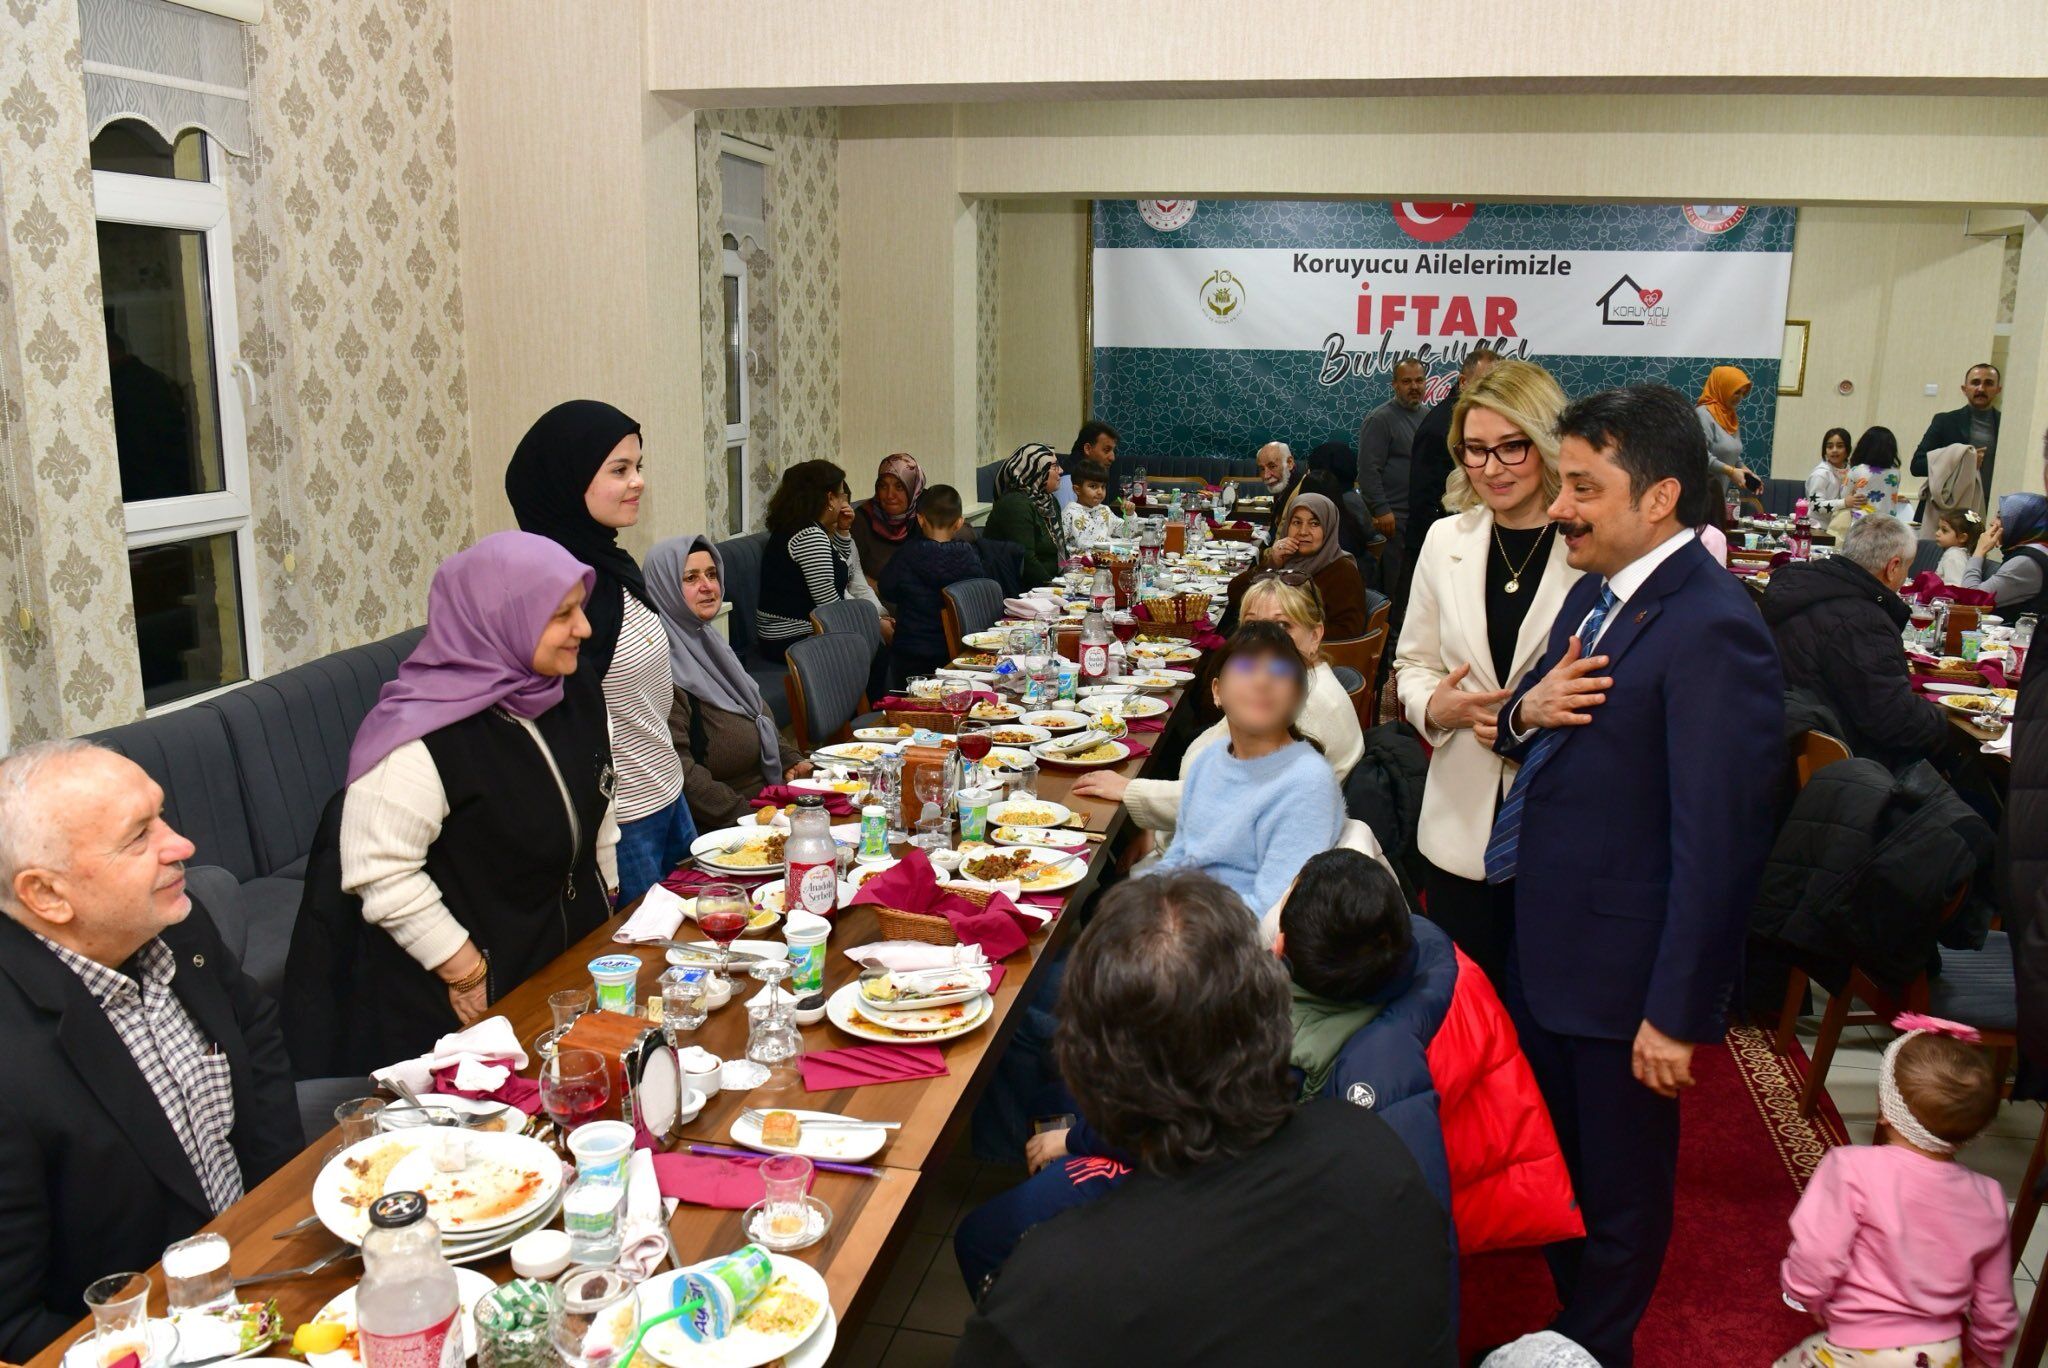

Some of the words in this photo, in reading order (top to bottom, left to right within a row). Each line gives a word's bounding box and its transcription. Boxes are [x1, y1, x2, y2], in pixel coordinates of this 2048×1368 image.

[1293, 253, 1408, 278] Koruyucu
[1415, 253, 1572, 275] Ailelerimizle
[1356, 281, 1518, 337] İFTAR
[1613, 306, 1669, 317] KORUYUCU
